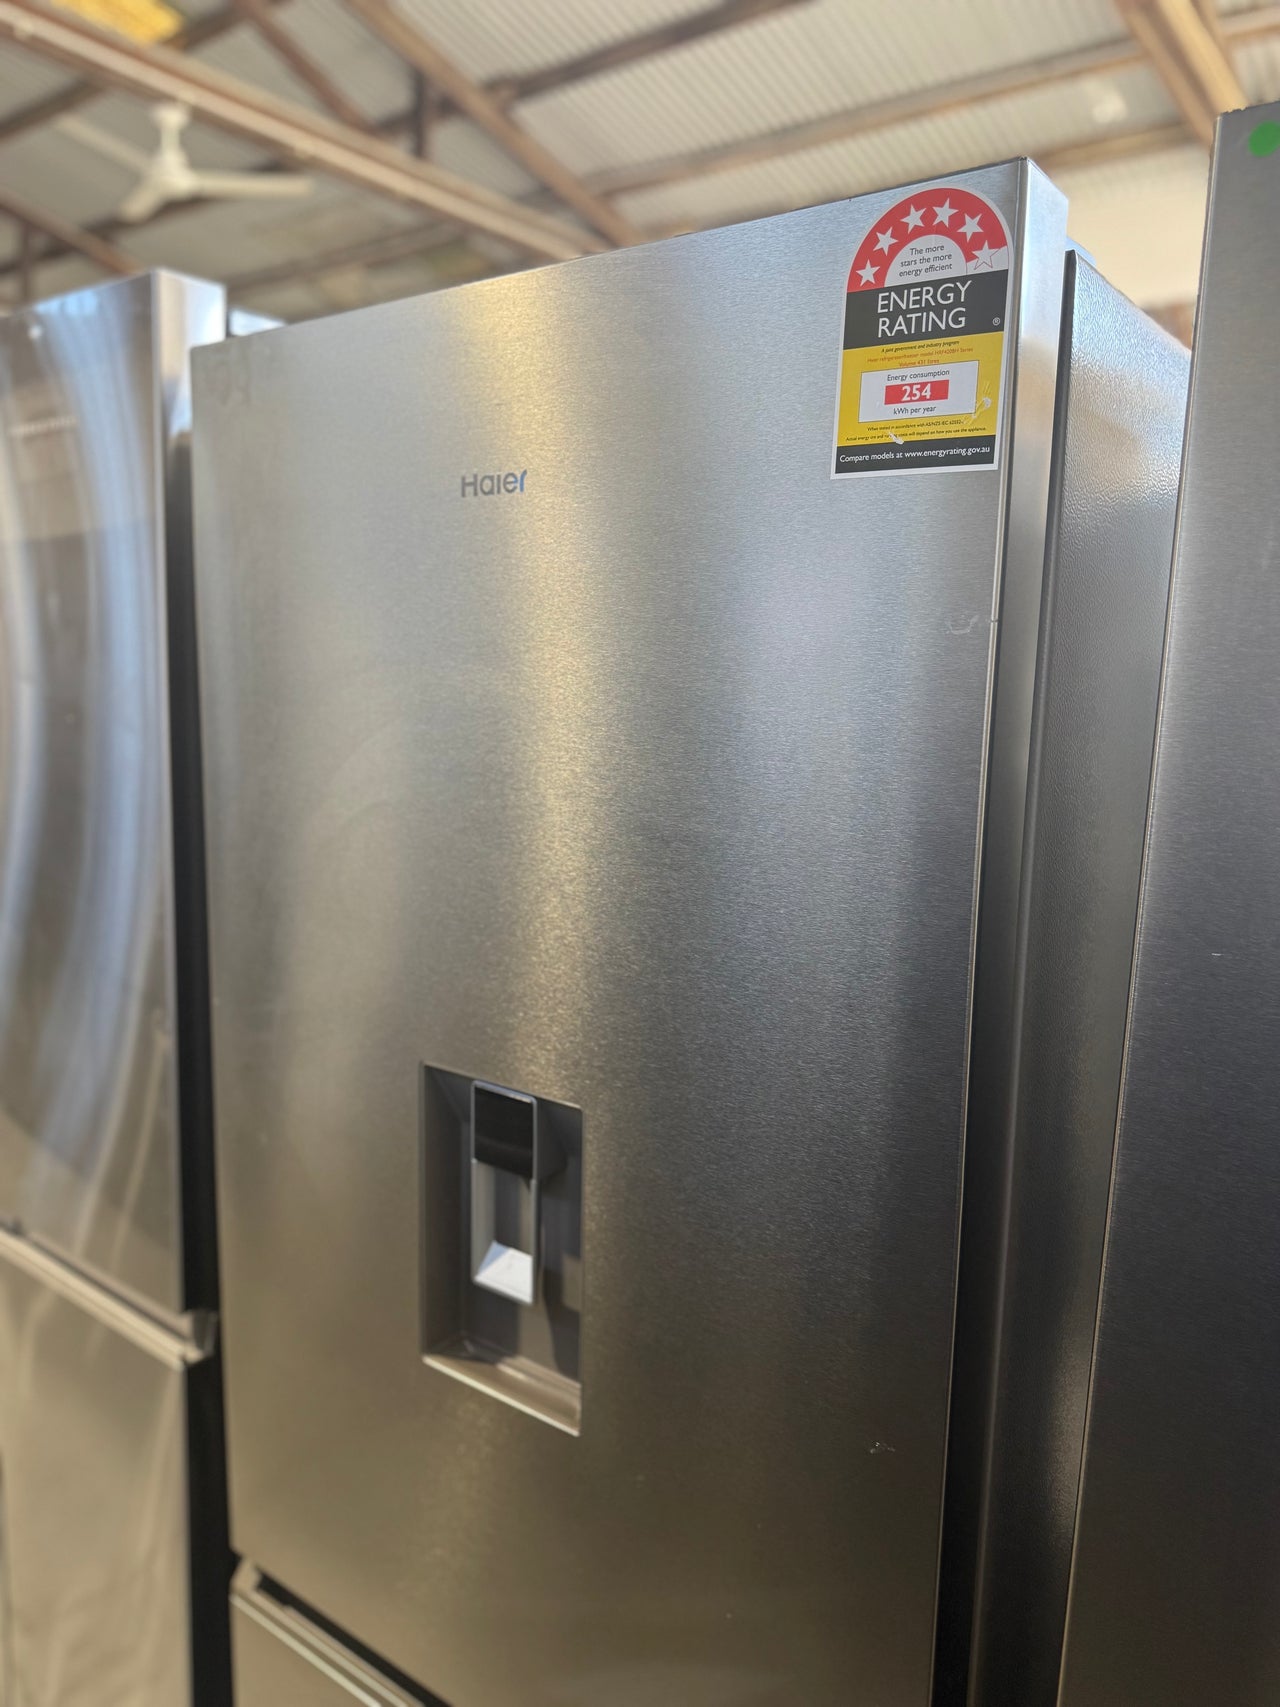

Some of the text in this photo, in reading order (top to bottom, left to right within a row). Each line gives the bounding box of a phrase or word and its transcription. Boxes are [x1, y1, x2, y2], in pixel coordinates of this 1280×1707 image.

[909, 244, 945, 256] The more
[900, 253, 952, 267] stars the more
[899, 263, 952, 277] energy efficient
[877, 280, 972, 313] ENERGY
[878, 307, 966, 338] RATING
[909, 369, 950, 380] consumption
[901, 383, 931, 401] 254
[893, 406, 936, 415] kWh per year
[839, 454, 870, 463] Compare
[870, 451, 895, 460] models
[904, 447, 991, 458] www.energyrating.gov.au
[461, 469, 528, 498] Haier
